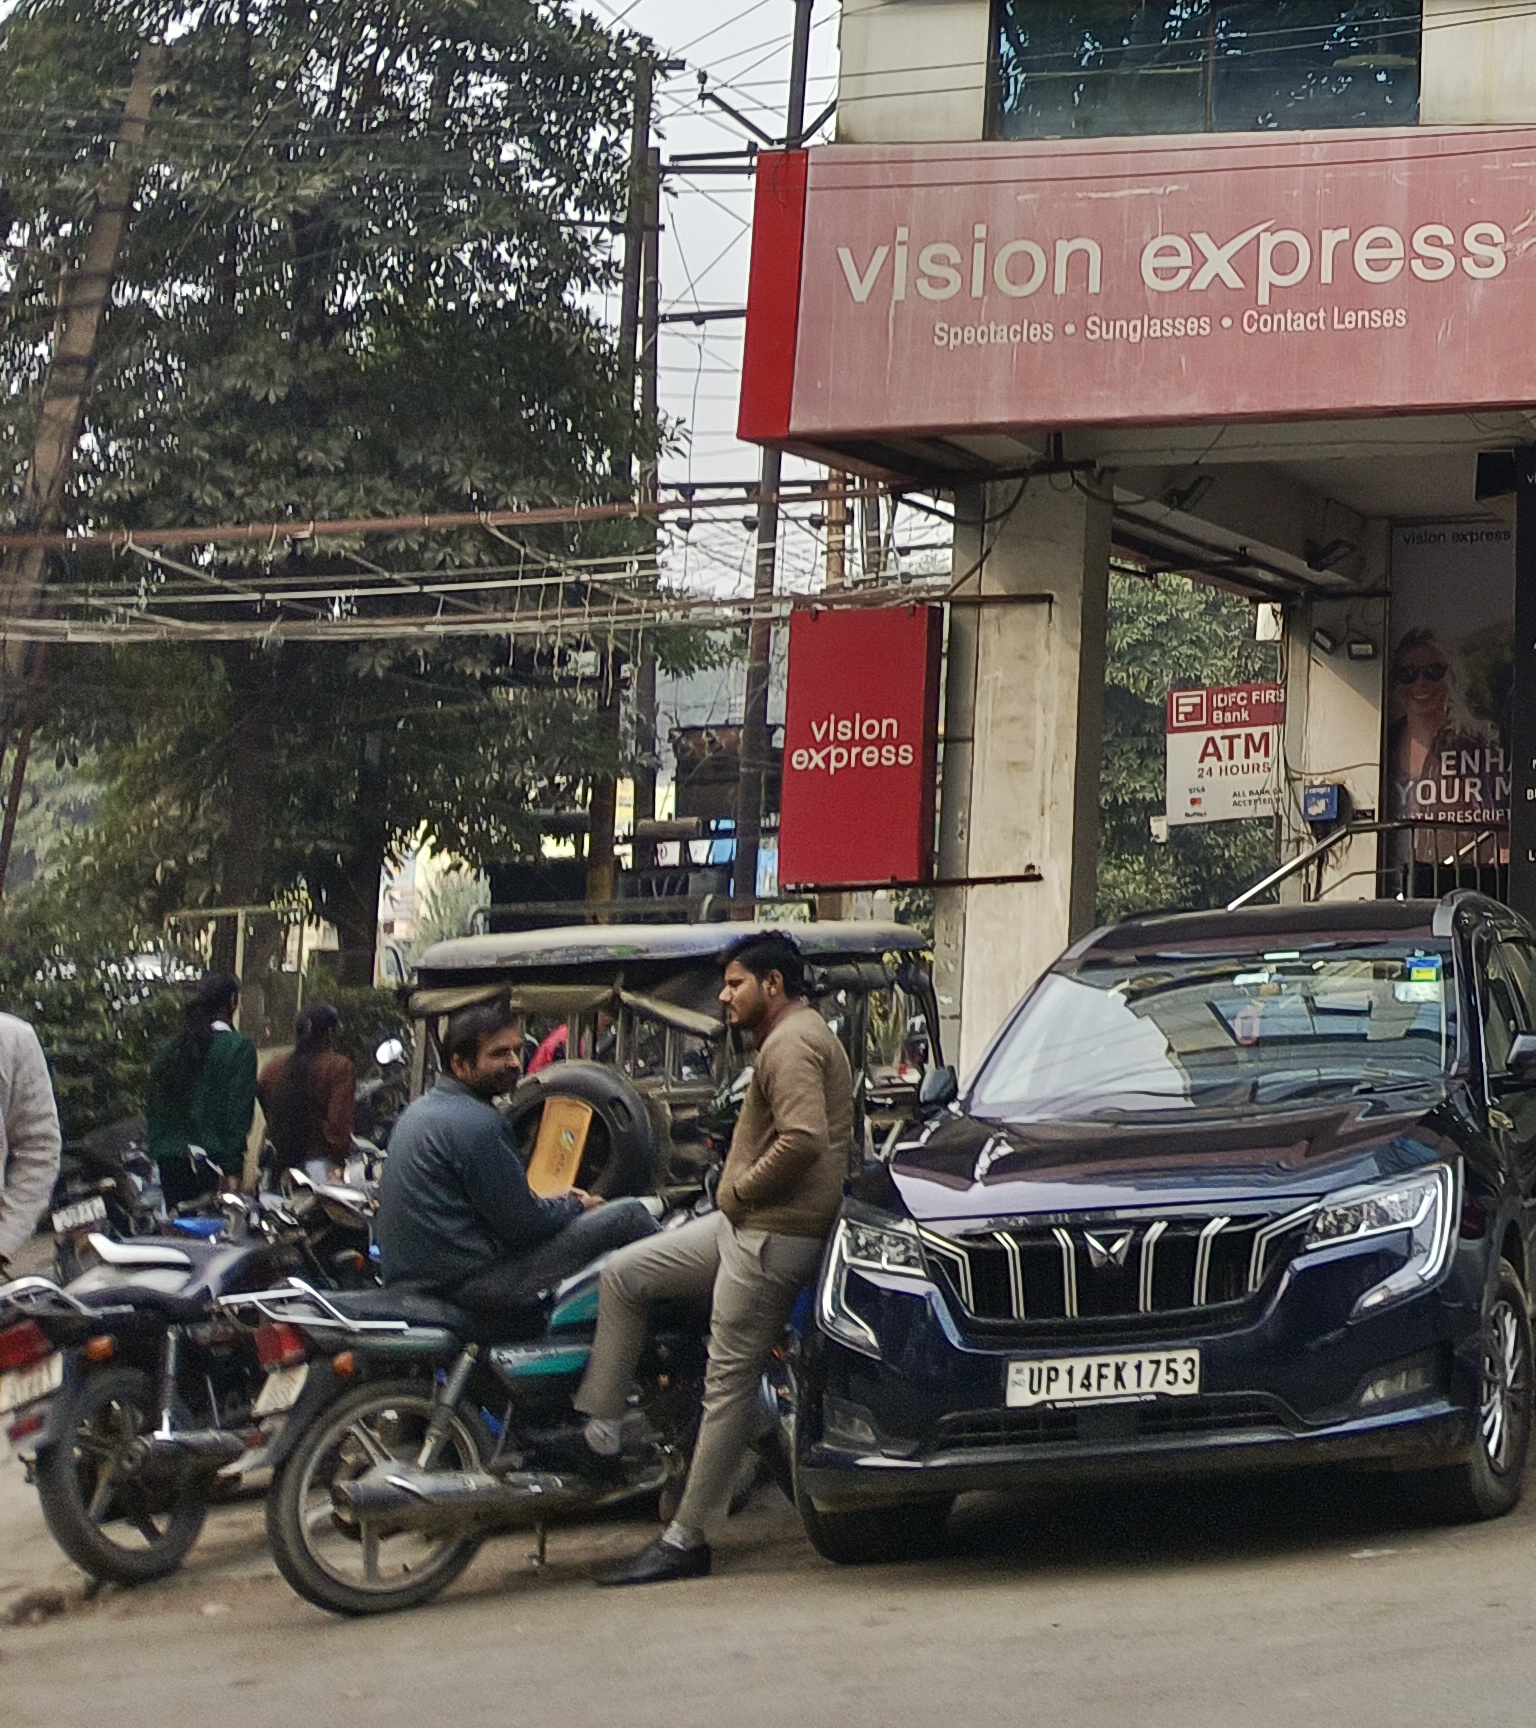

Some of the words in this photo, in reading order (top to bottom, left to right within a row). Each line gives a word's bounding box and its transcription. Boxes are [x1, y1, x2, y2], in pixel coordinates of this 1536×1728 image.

[836, 224, 1103, 304] vision
[1138, 218, 1510, 306] express
[932, 319, 1055, 350] Spectacles
[1084, 311, 1212, 343] Sunglasses
[1241, 306, 1327, 335] Contact
[1331, 304, 1408, 332] Lenses
[1211, 692, 1248, 709] IDFC
[1212, 707, 1250, 724] Bank
[811, 713, 898, 742] vision
[791, 743, 914, 775] express
[1198, 732, 1270, 764] ATM
[1197, 766, 1213, 779] 24
[1219, 762, 1272, 777] HOURS
[1438, 808, 1512, 824] PRESCRIPT
[1028, 1356, 1197, 1396] UP14FK1753
